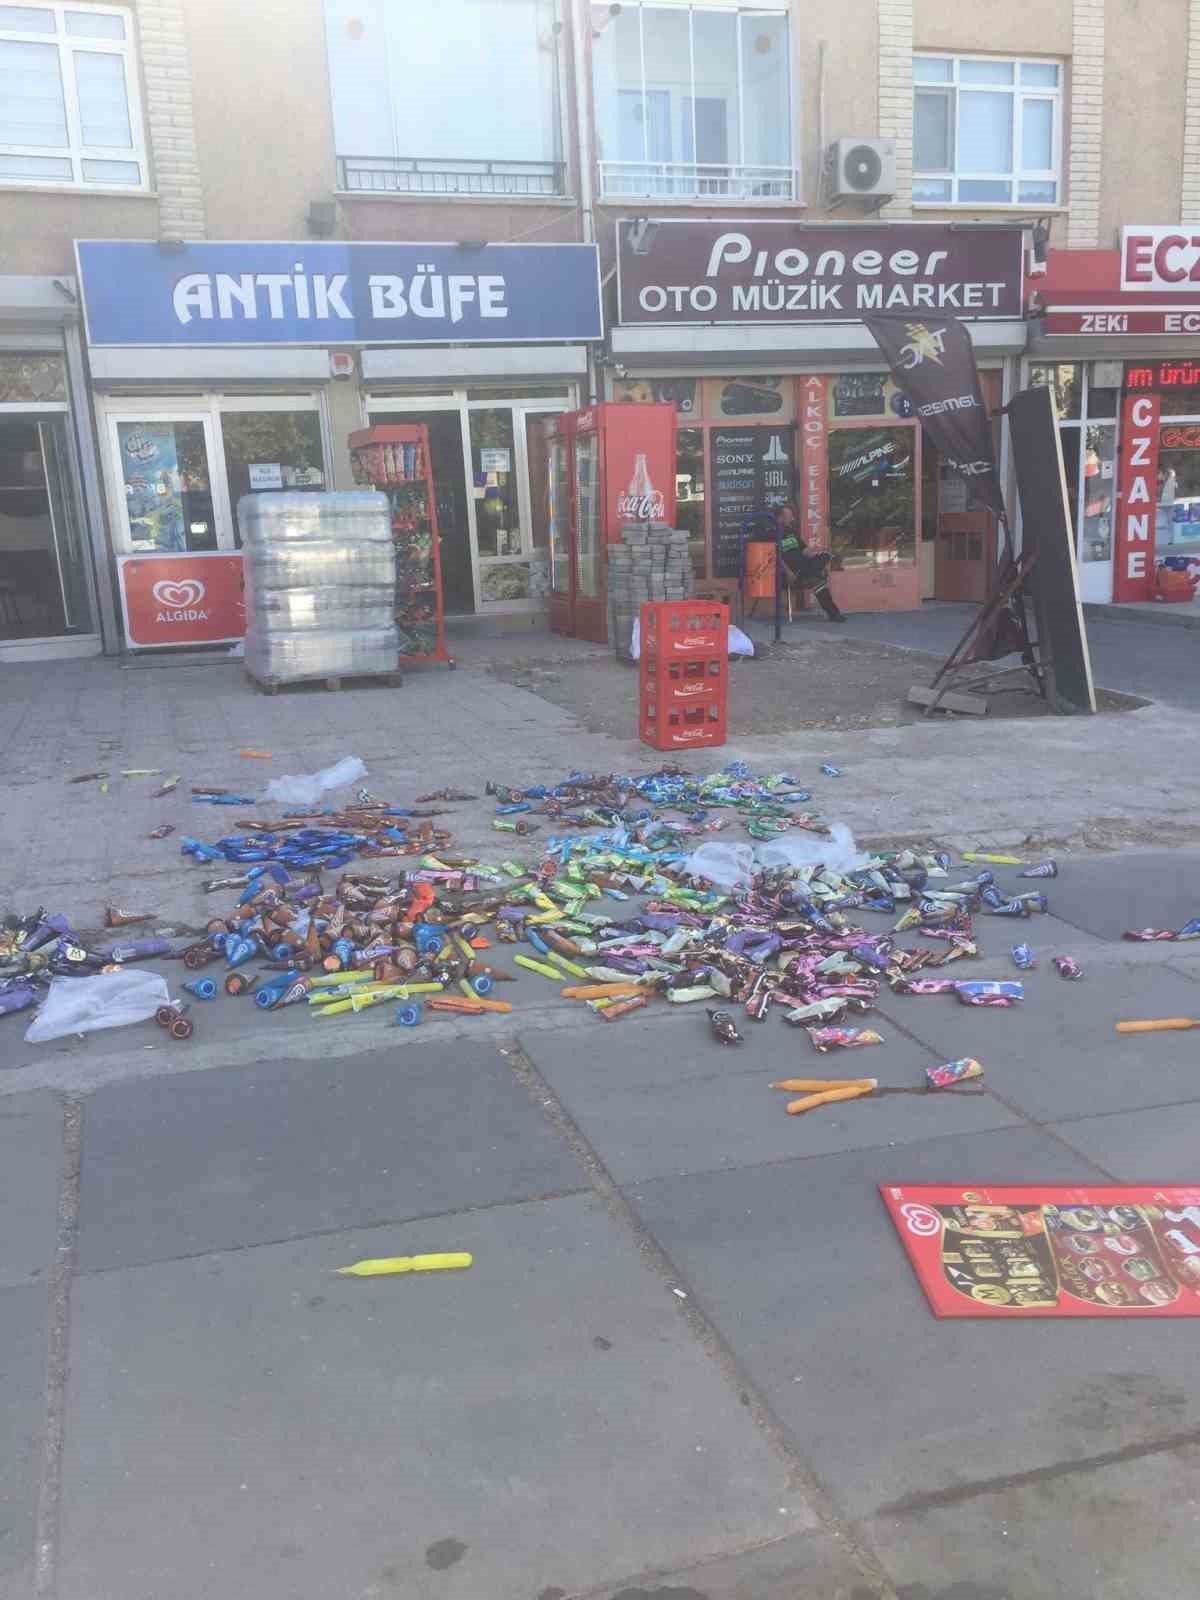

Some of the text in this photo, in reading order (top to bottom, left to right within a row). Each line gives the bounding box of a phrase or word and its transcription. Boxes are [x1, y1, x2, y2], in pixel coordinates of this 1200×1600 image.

[706, 232, 948, 277] Pioneer
[173, 263, 509, 325] ANTİK BÜFE
[639, 279, 1006, 312] OTO MÜZİK MARKET
[716, 455, 753, 464] SONY
[156, 610, 209, 623] ALGIDA
